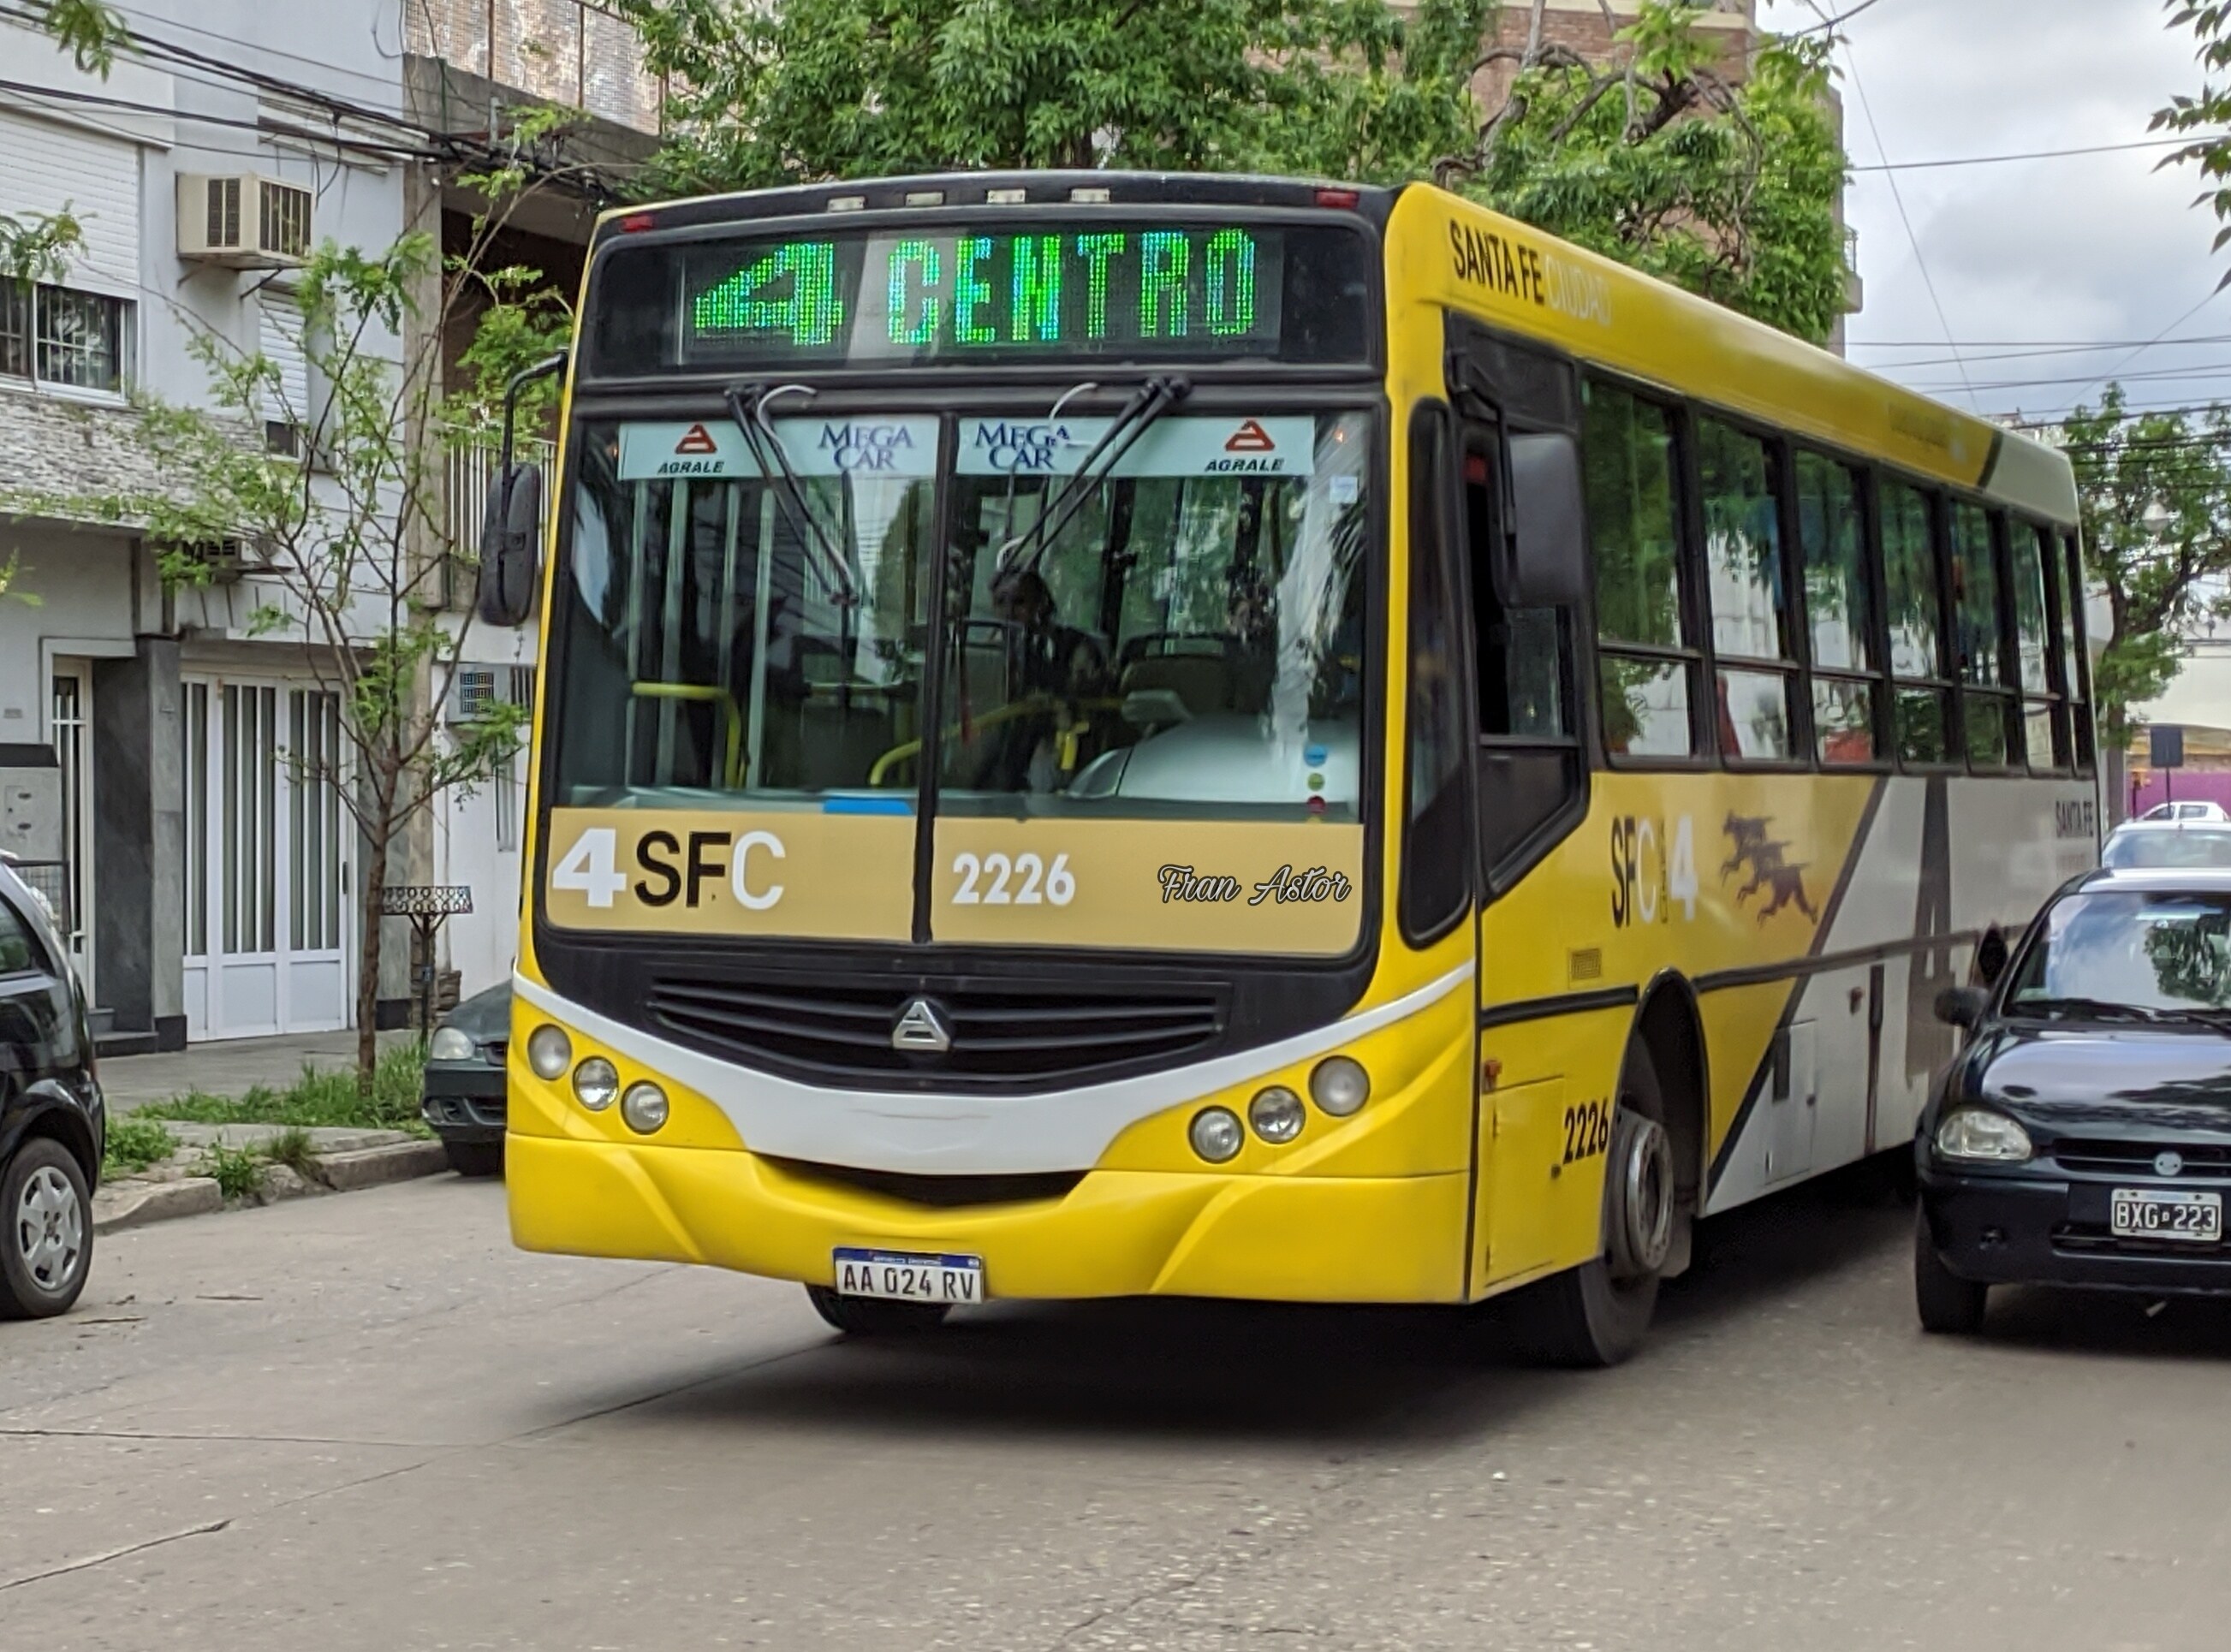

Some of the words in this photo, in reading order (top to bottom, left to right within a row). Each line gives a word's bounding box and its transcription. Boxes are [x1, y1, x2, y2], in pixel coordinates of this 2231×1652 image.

[1449, 218, 1518, 298] SANTA
[1518, 244, 1544, 306] FE
[693, 243, 844, 347] 4
[888, 229, 1256, 344] CENTRO
[818, 422, 913, 449] MEGA
[657, 461, 725, 475] AGRALE
[834, 446, 895, 470] CAR
[989, 444, 1056, 469] CAR
[1205, 457, 1284, 472] AGRALE
[950, 853, 1075, 906] 2226
[1611, 815, 1657, 928] SFC
[1671, 812, 1699, 922] 4
[1563, 1097, 1609, 1164] 2226
[2115, 1202, 2158, 1228] BXG
[2174, 1205, 2216, 1231] 223
[844, 1264, 874, 1292] AA
[884, 1267, 931, 1297] 024
[943, 1270, 973, 1299] RV
